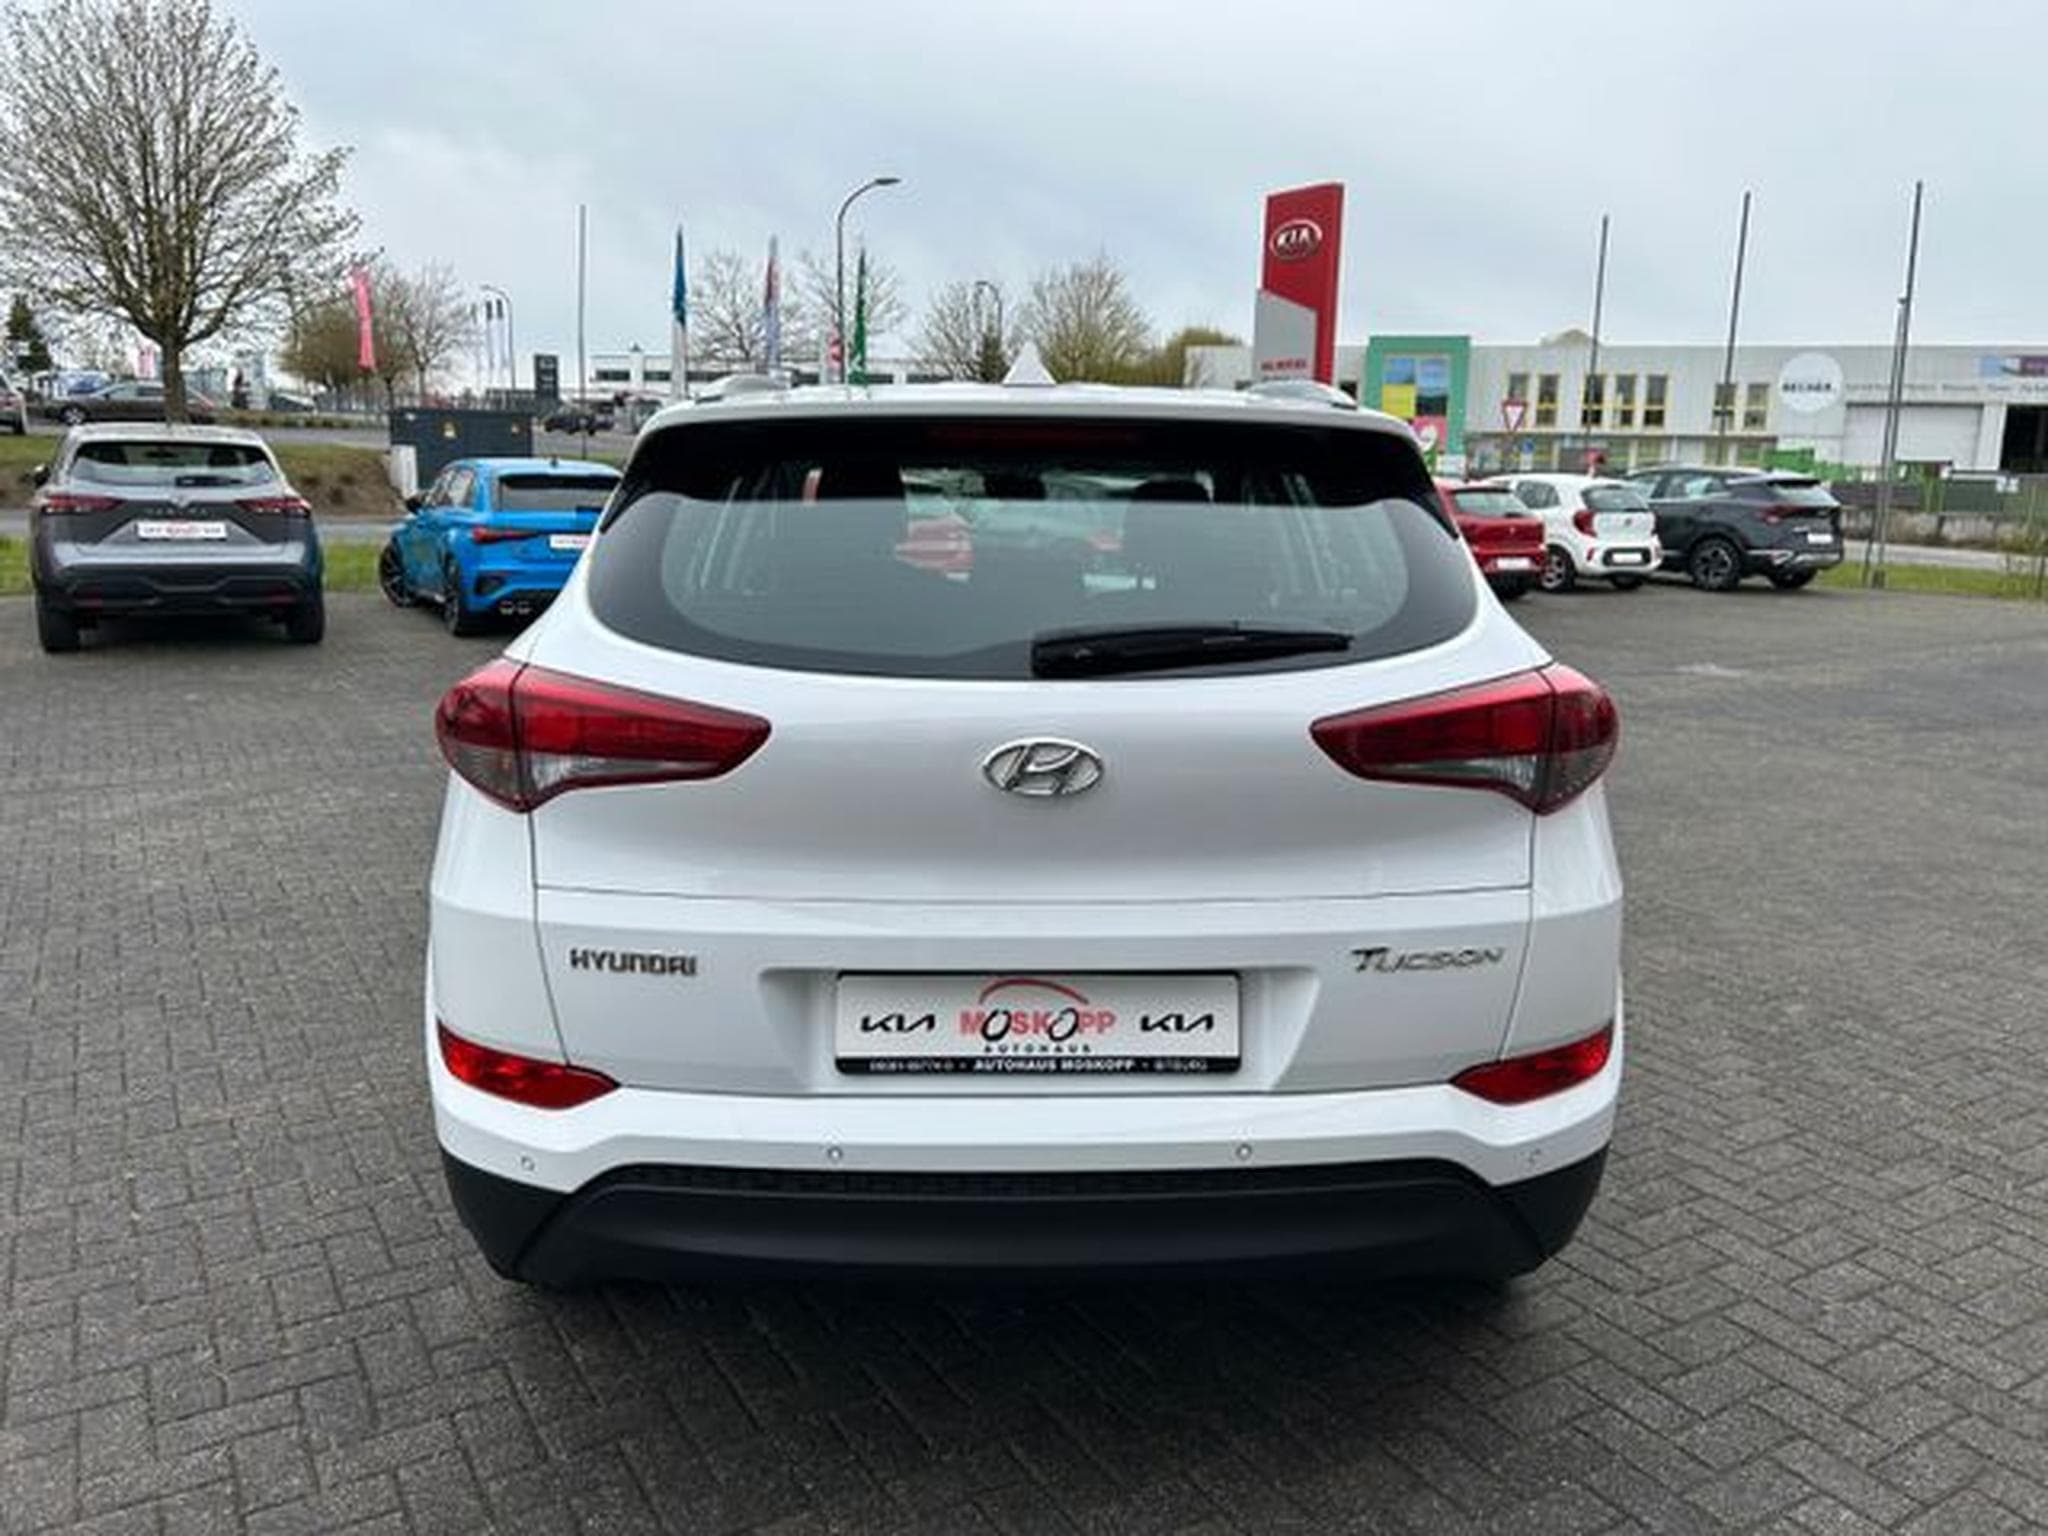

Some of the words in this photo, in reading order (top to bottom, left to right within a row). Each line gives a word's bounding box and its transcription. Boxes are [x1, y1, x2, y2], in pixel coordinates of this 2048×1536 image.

[1277, 227, 1314, 247] KIA
[569, 948, 696, 976] HYUNDAI
[861, 1013, 935, 1033] KIA
[959, 1008, 1116, 1042] MOSKOPP
[1140, 1013, 1214, 1033] KIA
[984, 1043, 1092, 1053] AUTOHAUS
[973, 1059, 1056, 1070] AUTOHAUS
[1060, 1059, 1134, 1070] MOSKOPP
